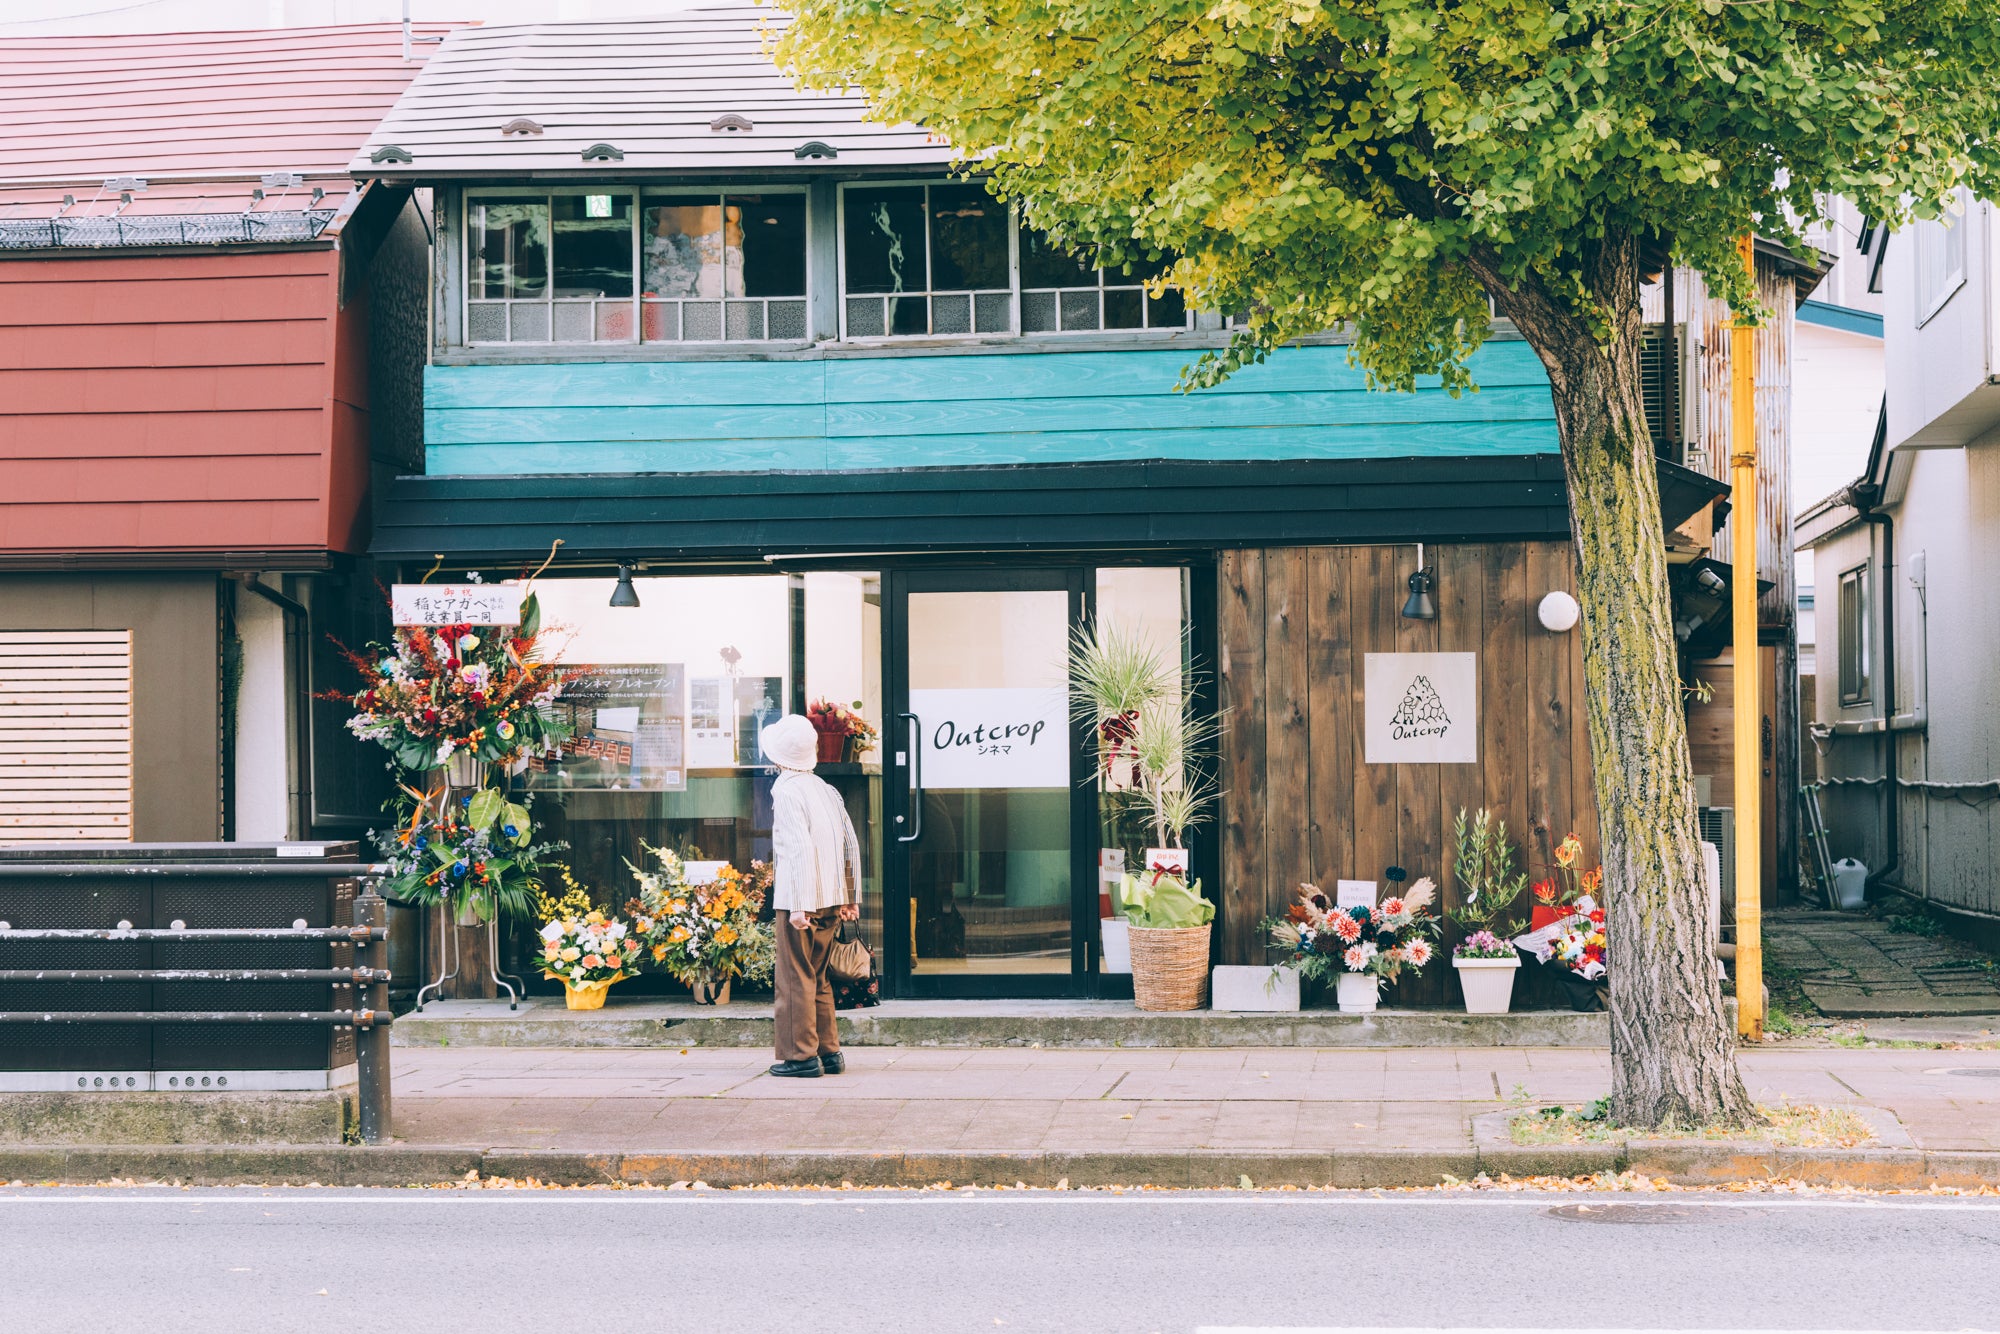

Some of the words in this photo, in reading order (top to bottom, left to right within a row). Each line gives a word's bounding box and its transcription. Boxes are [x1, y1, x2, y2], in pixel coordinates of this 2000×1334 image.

[413, 597, 489, 611] 稲とアガベ
[424, 610, 491, 624] 従業員一同
[933, 720, 1045, 750] Outcrop
[1392, 725, 1448, 741] Outcrop
[978, 744, 1012, 756] シネマ
